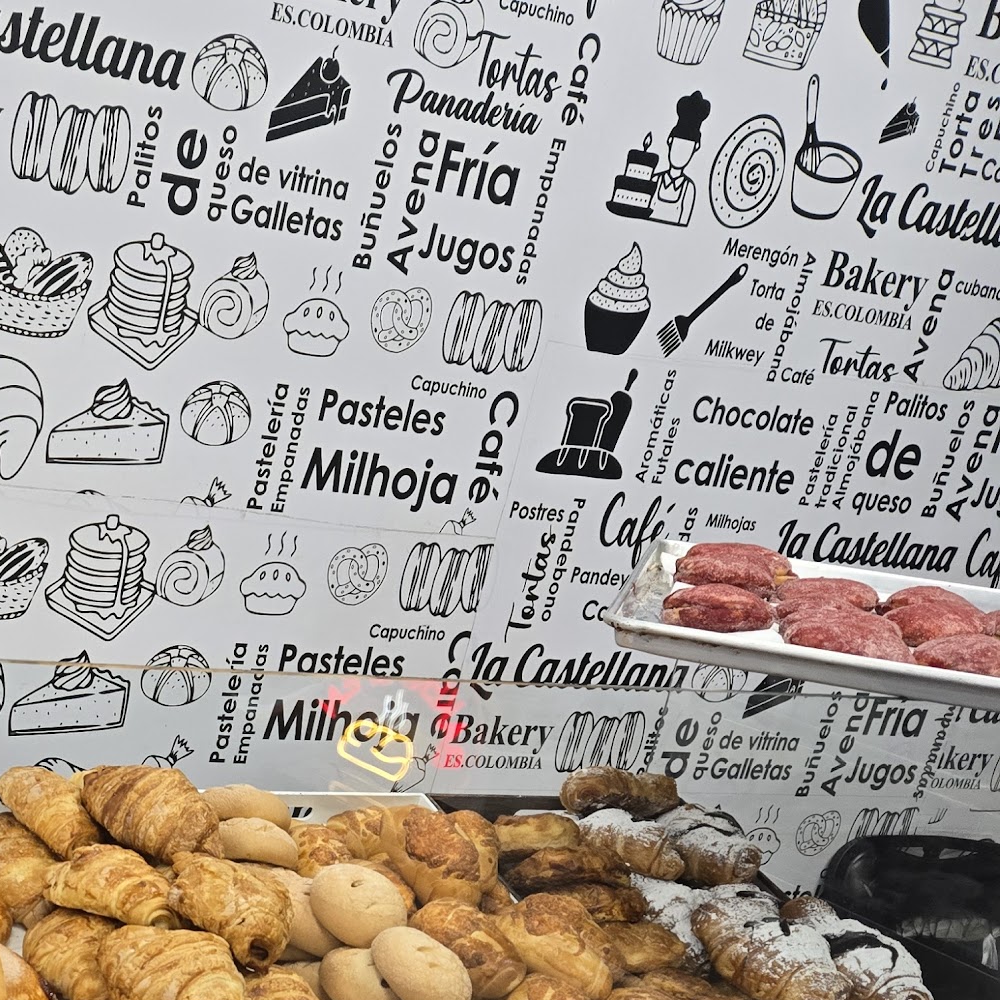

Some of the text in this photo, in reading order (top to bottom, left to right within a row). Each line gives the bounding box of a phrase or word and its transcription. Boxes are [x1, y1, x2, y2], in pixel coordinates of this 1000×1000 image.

[268, 1, 396, 49] ES.COLOMBIA
[500, 0, 573, 25] Capuchino
[467, 30, 562, 104] Tortas
[562, 33, 600, 125] Café
[386, 68, 543, 135] Panadería
[926, 83, 963, 173] Capuchino
[938, 91, 983, 173] Torta
[127, 106, 162, 207] Palitos
[161, 129, 207, 215] de
[208, 126, 237, 221] queso
[239, 157, 349, 200] de vitrina
[435, 140, 520, 206] Fría
[232, 195, 343, 241] Galletas
[352, 124, 401, 269] Buñuelos
[387, 130, 440, 275] Avena
[516, 138, 566, 284] Empanadas
[857, 175, 896, 238] La
[418, 223, 515, 274] Jugos
[723, 238, 798, 267] Merengón
[751, 279, 785, 300] Torta
[821, 250, 929, 311] Bakery
[756, 313, 774, 331] de
[765, 250, 816, 383] Almojábana
[812, 299, 913, 331] ES.COLOMBIA
[902, 269, 956, 384] Avena
[705, 339, 764, 366] Milkwey
[781, 368, 815, 385] Café
[820, 338, 898, 382] Tortas
[318, 389, 446, 435] Pasteles
[412, 375, 486, 399] Capuchino
[693, 396, 813, 435] Chocolate
[884, 391, 948, 421] Palitos
[247, 384, 293, 512] Pastelería
[268, 384, 310, 512] Empanadas
[469, 391, 519, 503] Café
[636, 370, 677, 484] Aromáticas
[815, 406, 860, 510] tradicional
[832, 391, 879, 510] Almojábana
[866, 429, 921, 480] de
[921, 400, 975, 517] Buñuelos
[301, 447, 458, 512] Milhoja
[675, 454, 794, 494] caliente
[799, 415, 841, 508] Pastelería
[946, 405, 1000, 522] Avena
[510, 501, 564, 522] Postres
[706, 514, 756, 533] Milhojas
[852, 492, 911, 515] queso
[542, 498, 586, 621] Pandebono
[778, 518, 959, 573] La Castellana
[505, 525, 557, 644] Tortas
[569, 566, 630, 591] Pandey
[278, 643, 406, 678] Pasteles
[370, 624, 445, 642] Capuchino
[208, 641, 249, 764] Pastelería
[470, 641, 690, 701] La Castellana
[233, 643, 269, 765] Empanadas
[450, 713, 555, 755] Bakery
[443, 754, 543, 770] ES.COLOMBIA
[660, 717, 700, 780] de
[693, 712, 721, 780] queso
[711, 758, 792, 780] Galletas
[719, 730, 800, 751] de vitrina
[795, 692, 841, 797] Buñuelos
[821, 692, 869, 797] Avena
[845, 757, 918, 790] Jugos
